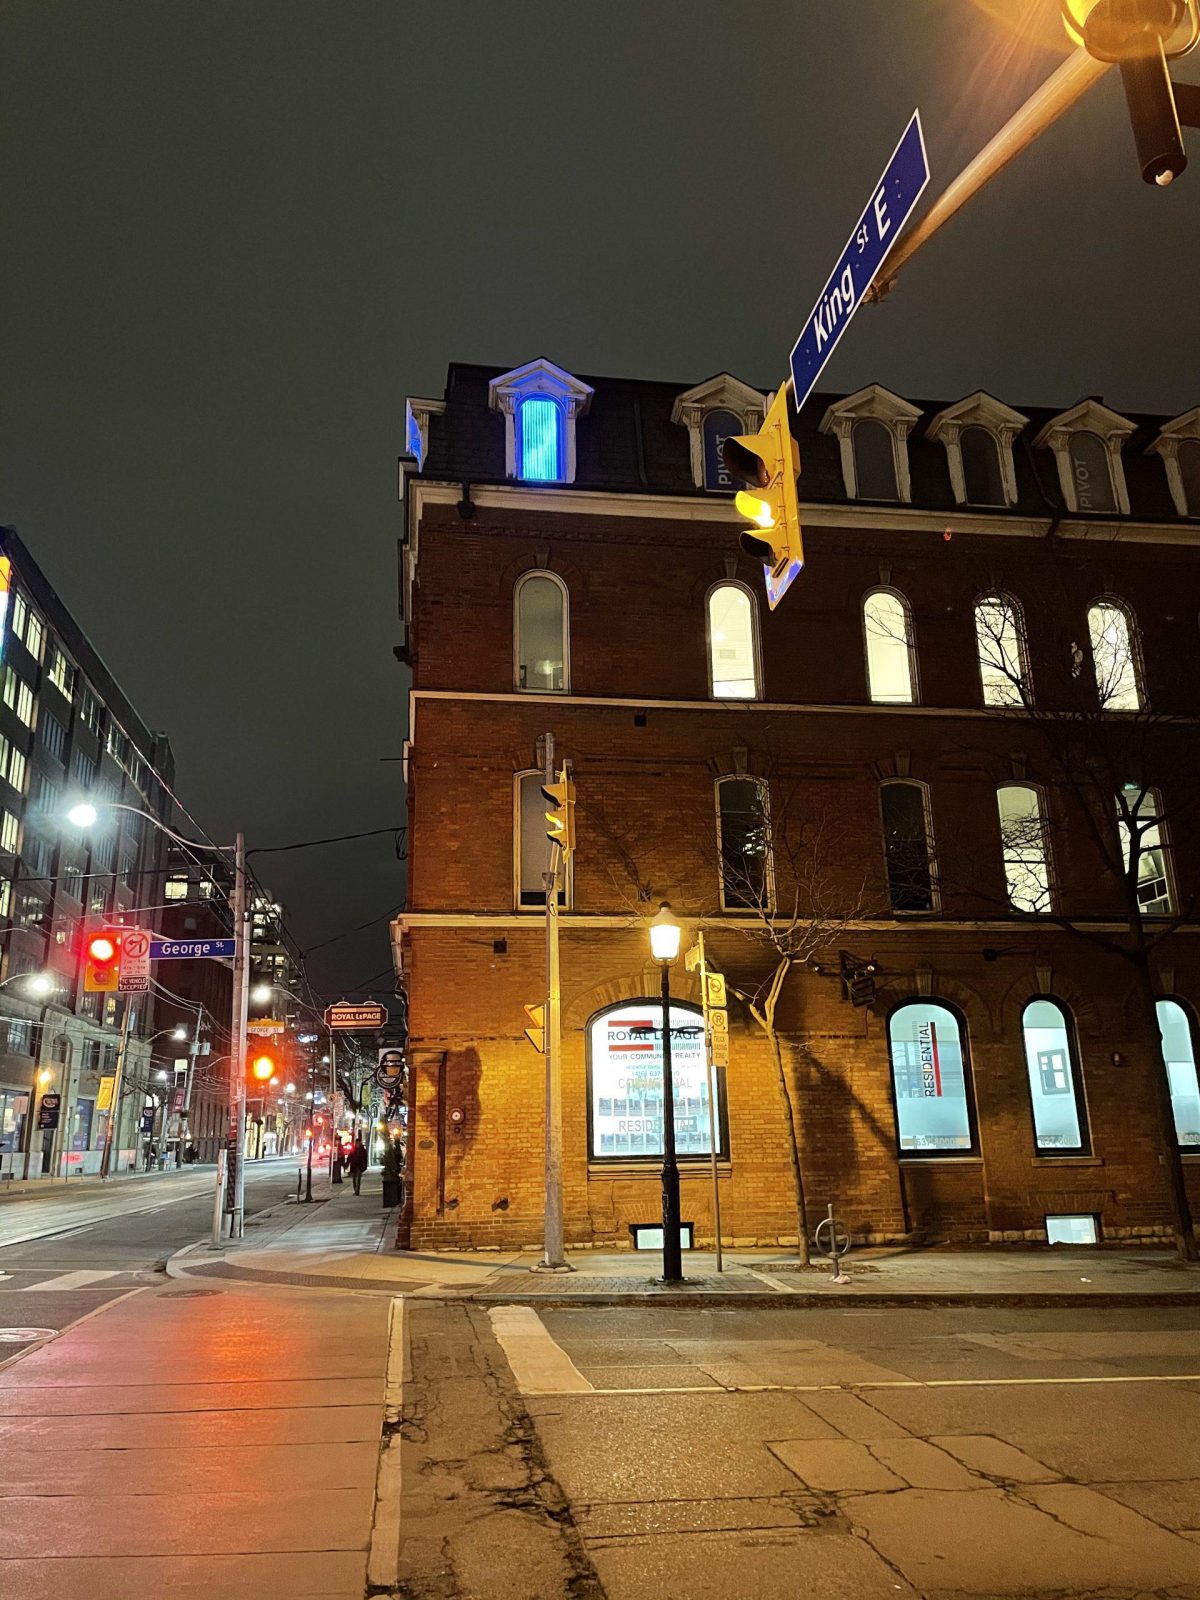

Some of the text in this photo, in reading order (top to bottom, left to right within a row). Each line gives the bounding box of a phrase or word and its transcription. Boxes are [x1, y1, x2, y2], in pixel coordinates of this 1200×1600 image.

[814, 185, 891, 353] King St E
[1074, 458, 1093, 507] PIVOT
[162, 942, 210, 957] George
[331, 1012, 354, 1020] ROYAL
[608, 1030, 649, 1041] ROYAL
[919, 1021, 936, 1097] RESIDENTIAL
